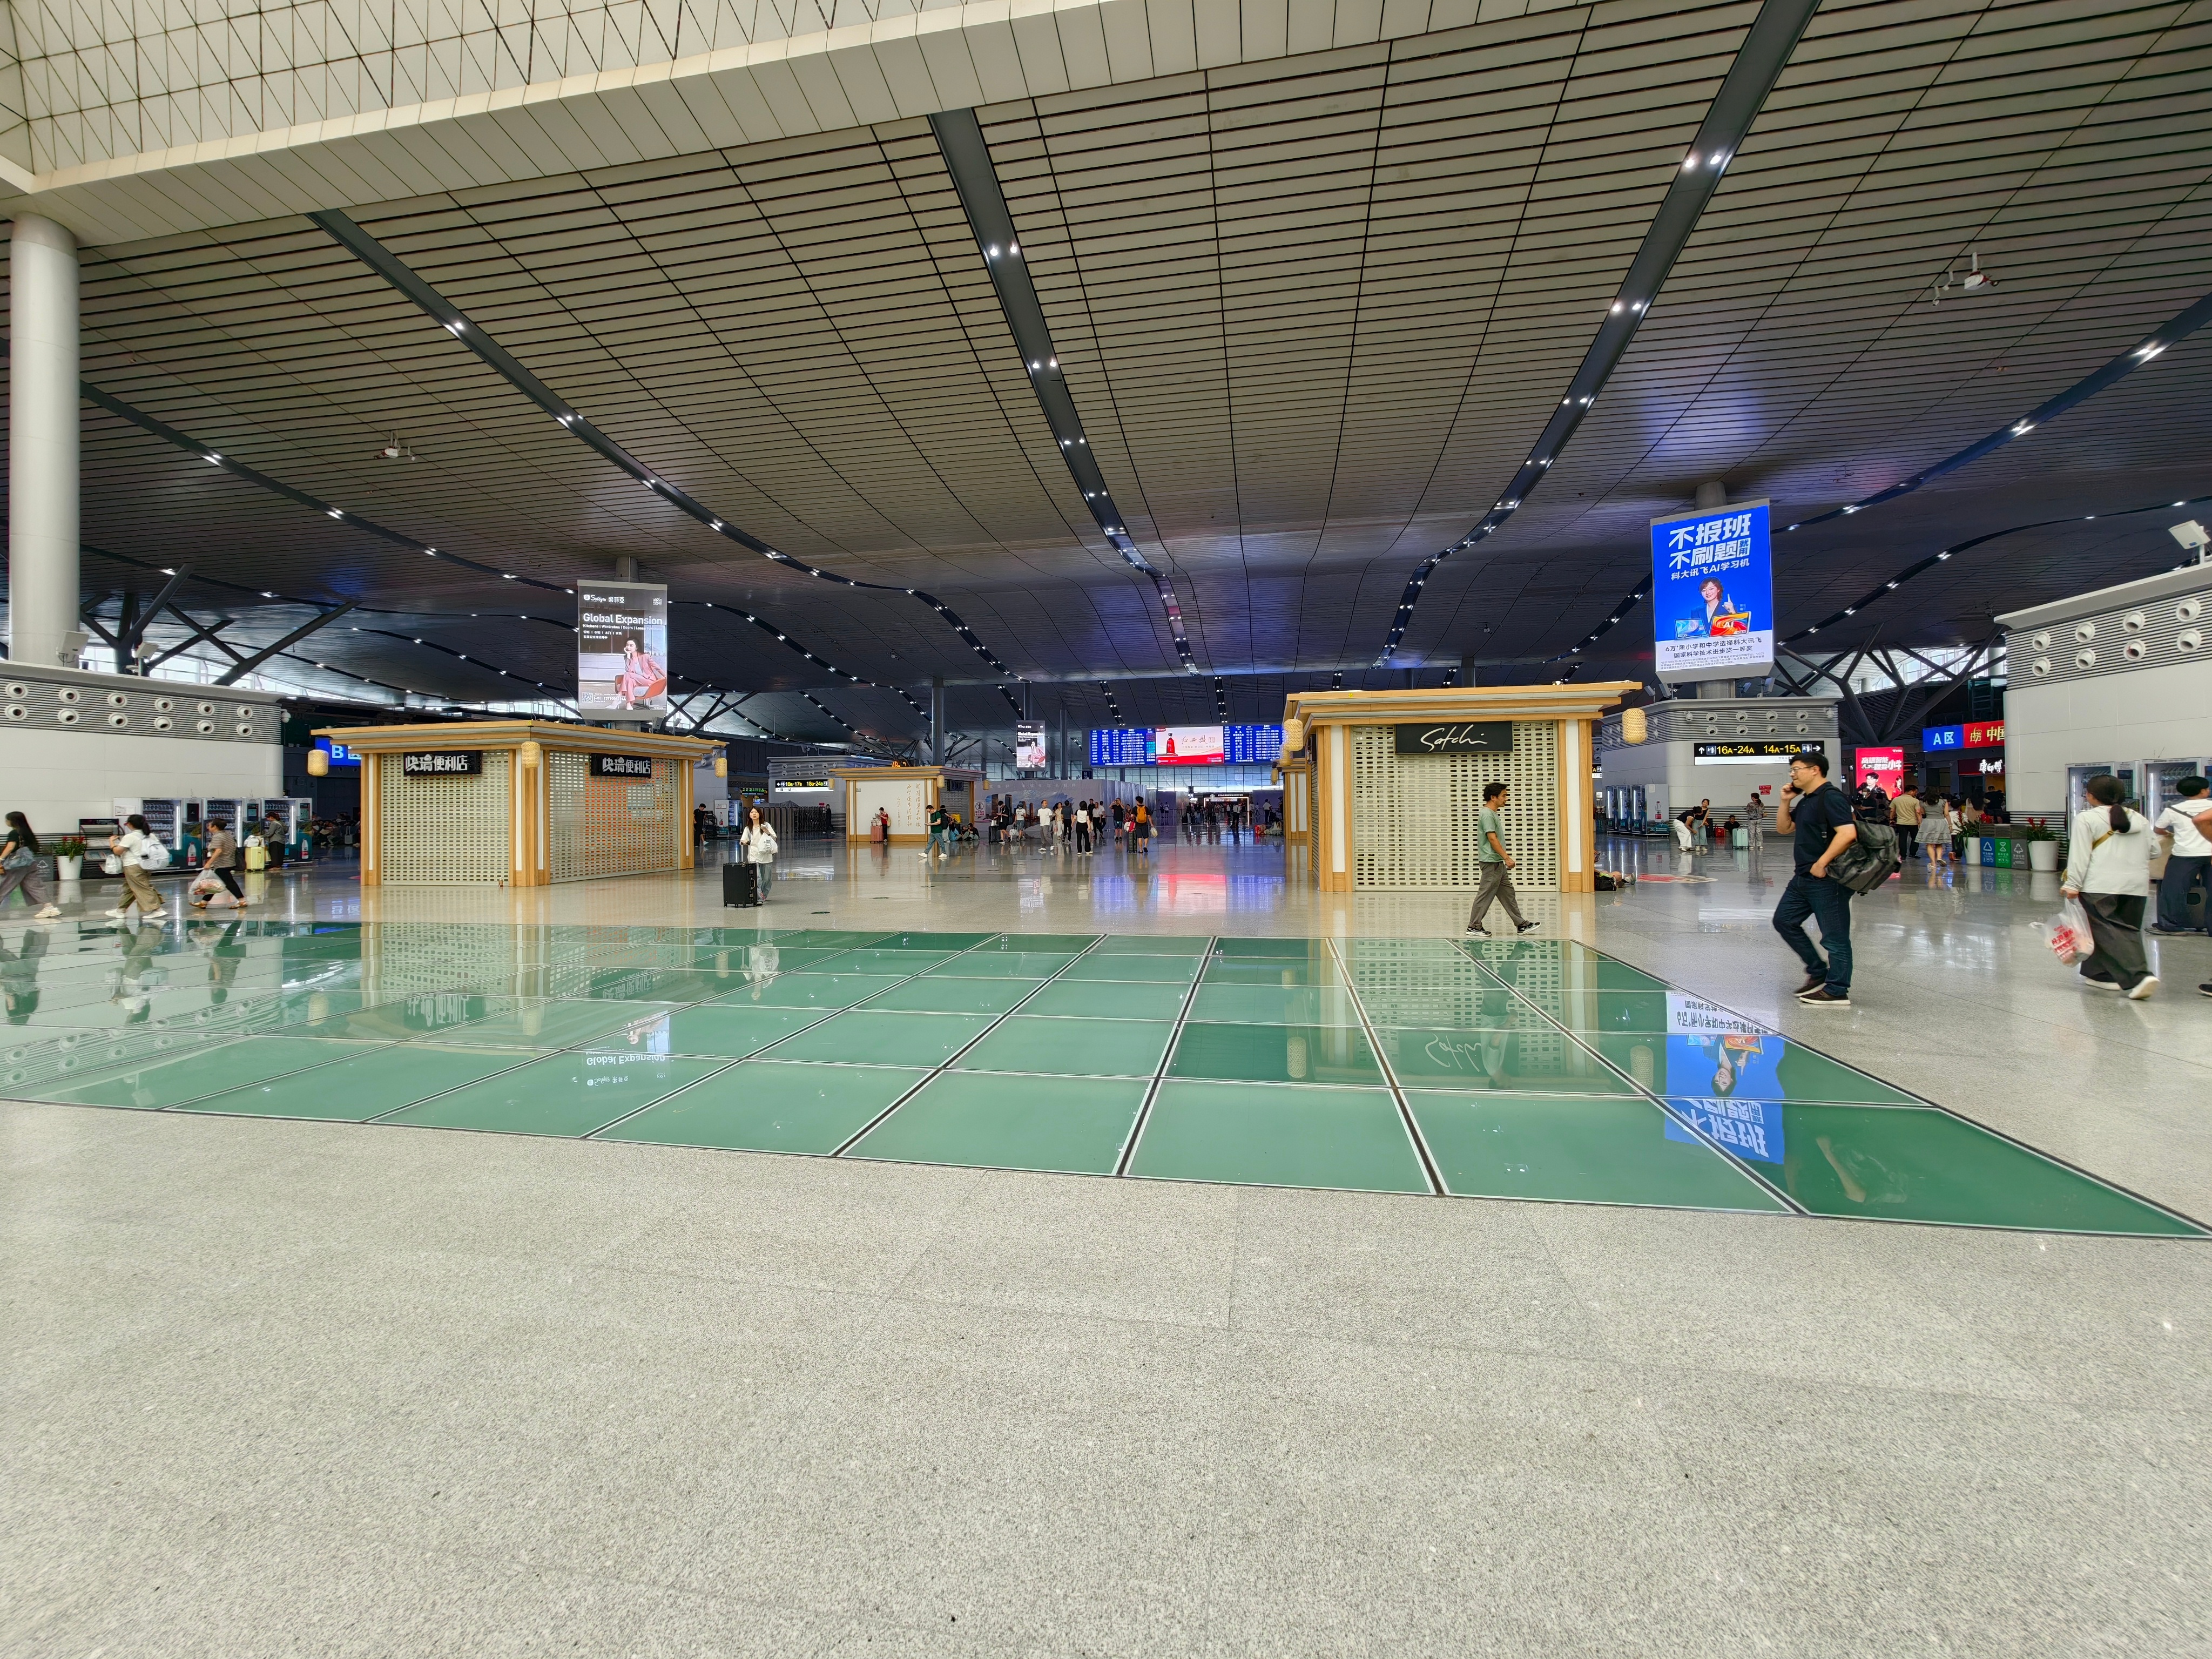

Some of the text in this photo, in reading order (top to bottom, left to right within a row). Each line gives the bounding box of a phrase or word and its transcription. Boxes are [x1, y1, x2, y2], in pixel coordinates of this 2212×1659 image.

[1668, 513, 1752, 550] 不报班
[1669, 540, 1737, 570] 不刷题
[1738, 539, 1749, 556] 就用
[1670, 558, 1750, 581] 科大讯飞AI学习机
[583, 613, 663, 625] Global Expansion
[1674, 645, 1753, 658] 国家科学技术进步奖一等奖
[1933, 731, 1954, 745] A区
[1717, 744, 1801, 754] 16A-24A 14A-15A
